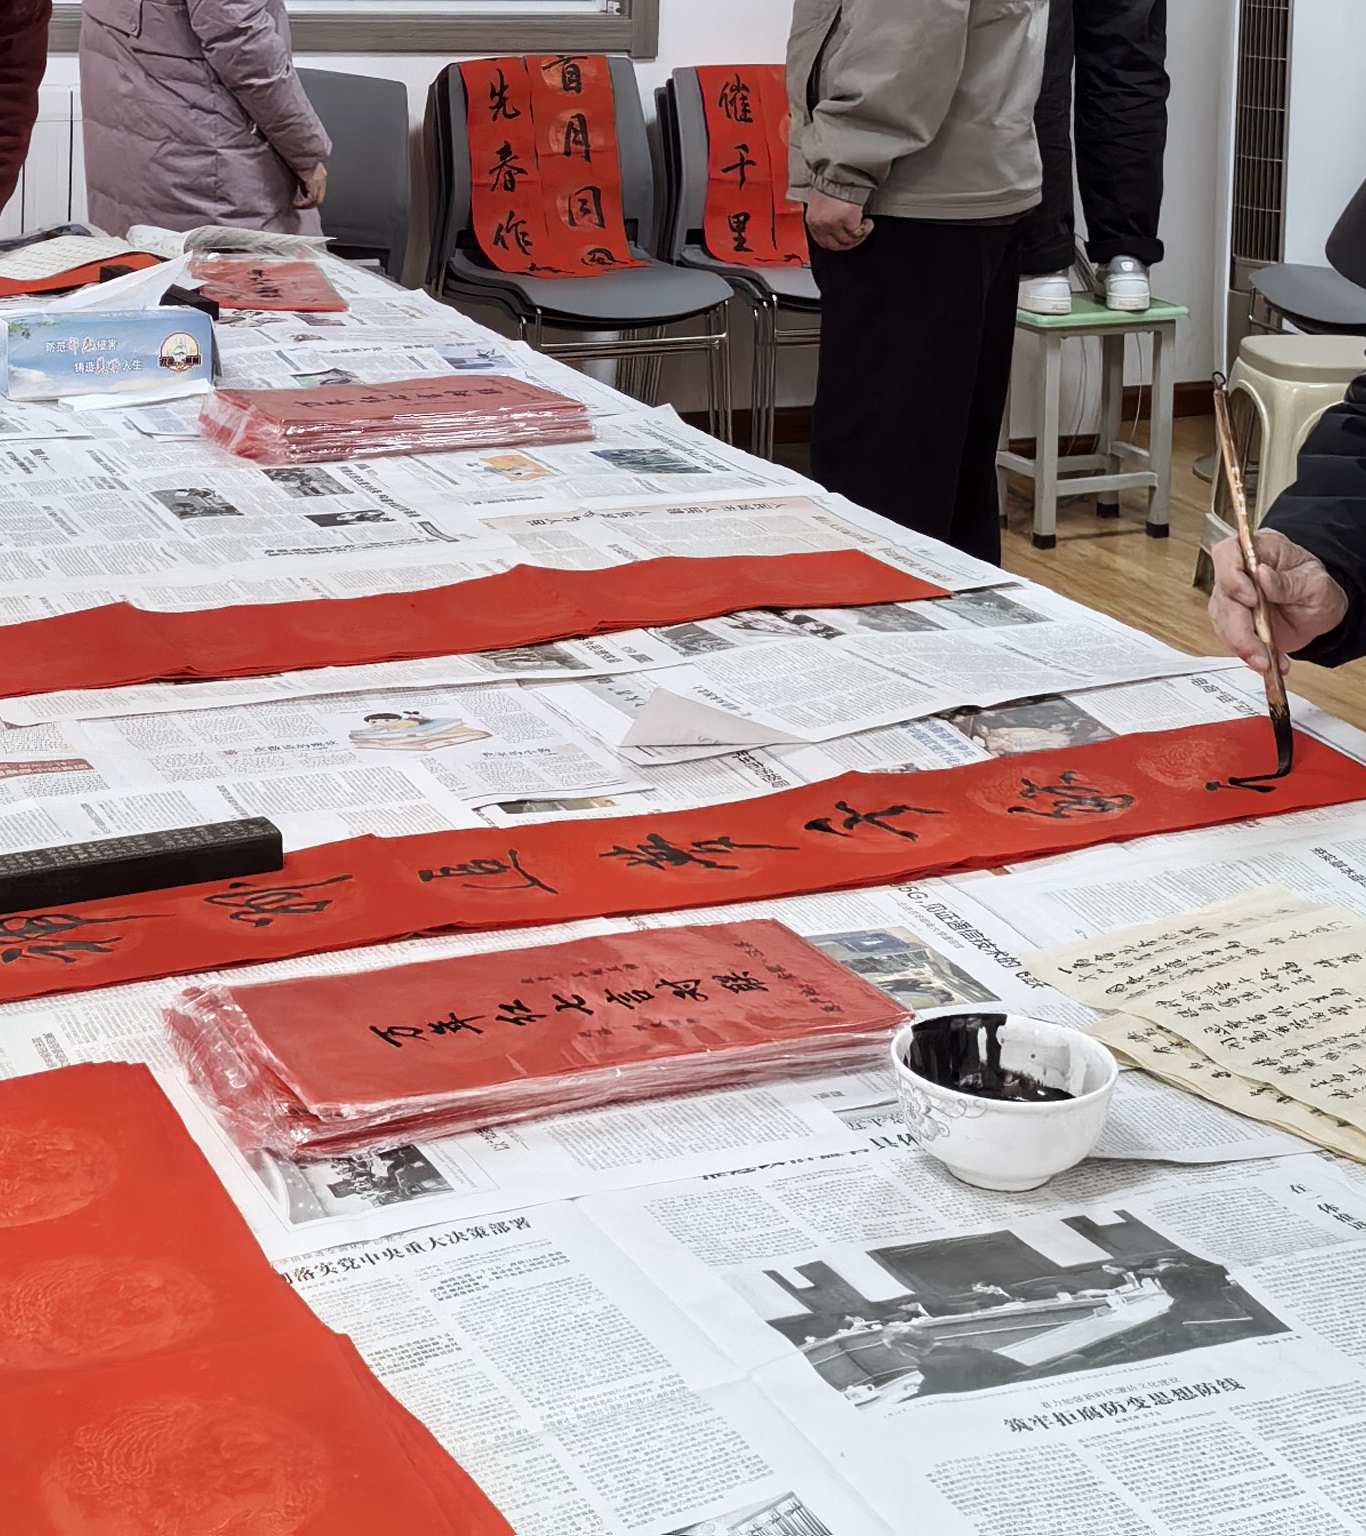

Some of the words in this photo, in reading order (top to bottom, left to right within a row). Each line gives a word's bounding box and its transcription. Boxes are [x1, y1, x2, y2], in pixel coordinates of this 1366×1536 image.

[1003, 1375, 1247, 1433] 筑牢拒腐防变思想防线
